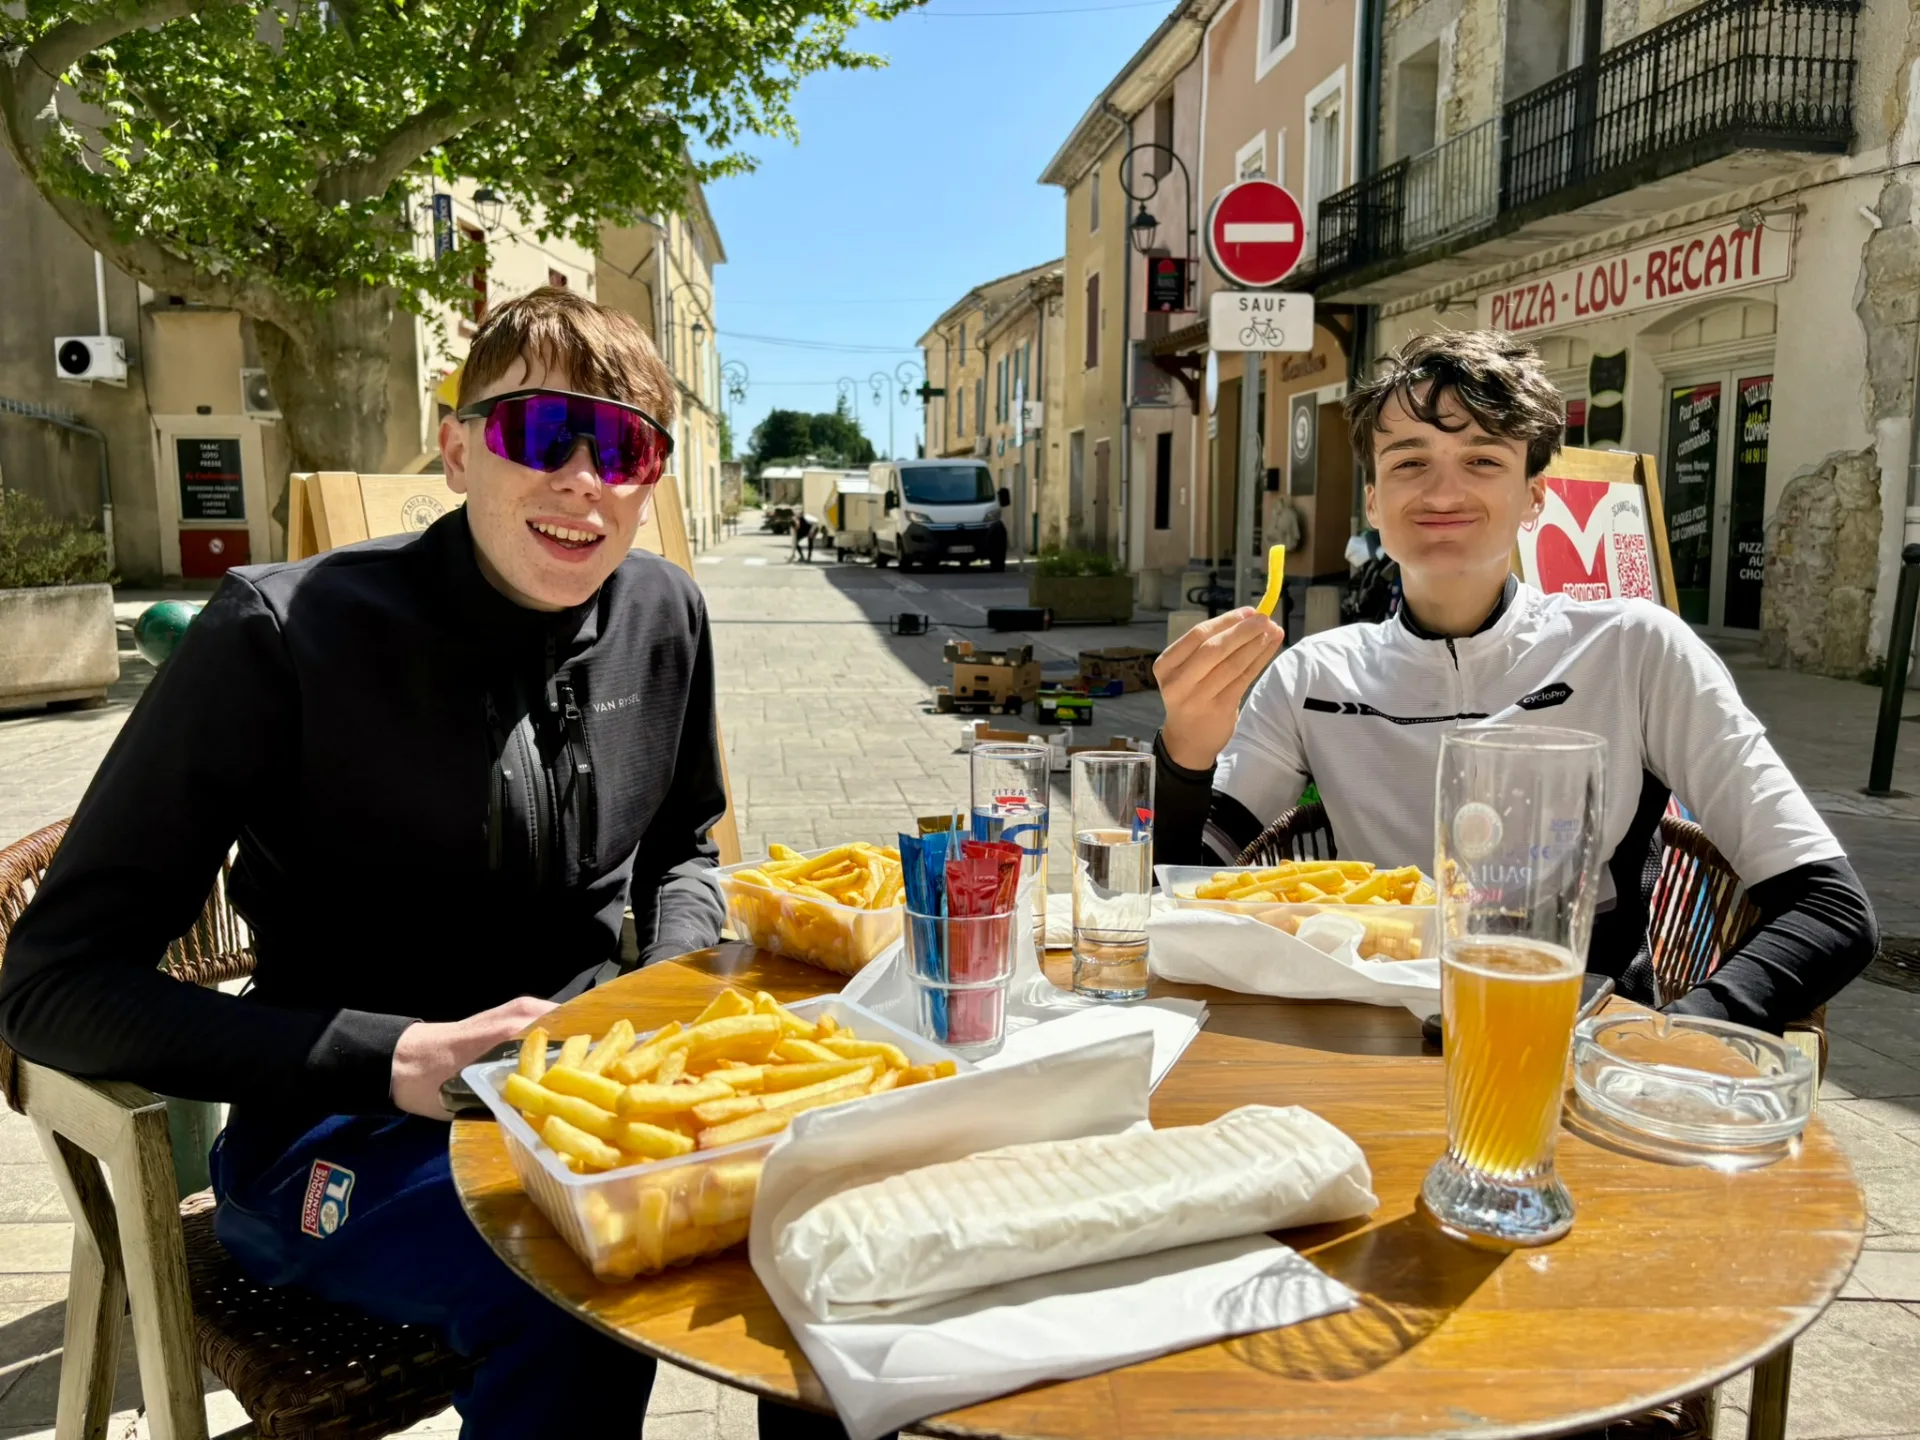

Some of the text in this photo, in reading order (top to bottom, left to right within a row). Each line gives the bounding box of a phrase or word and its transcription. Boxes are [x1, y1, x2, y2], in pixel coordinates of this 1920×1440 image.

[1491, 280, 1556, 331] PIZZA
[1574, 258, 1628, 317] LOU
[1645, 223, 1765, 301] RECATI
[1238, 297, 1287, 312] SAUF
[1679, 403, 1693, 423] Pour
[1677, 429, 1711, 457] commandes
[593, 693, 641, 713] VAN RYSEL
